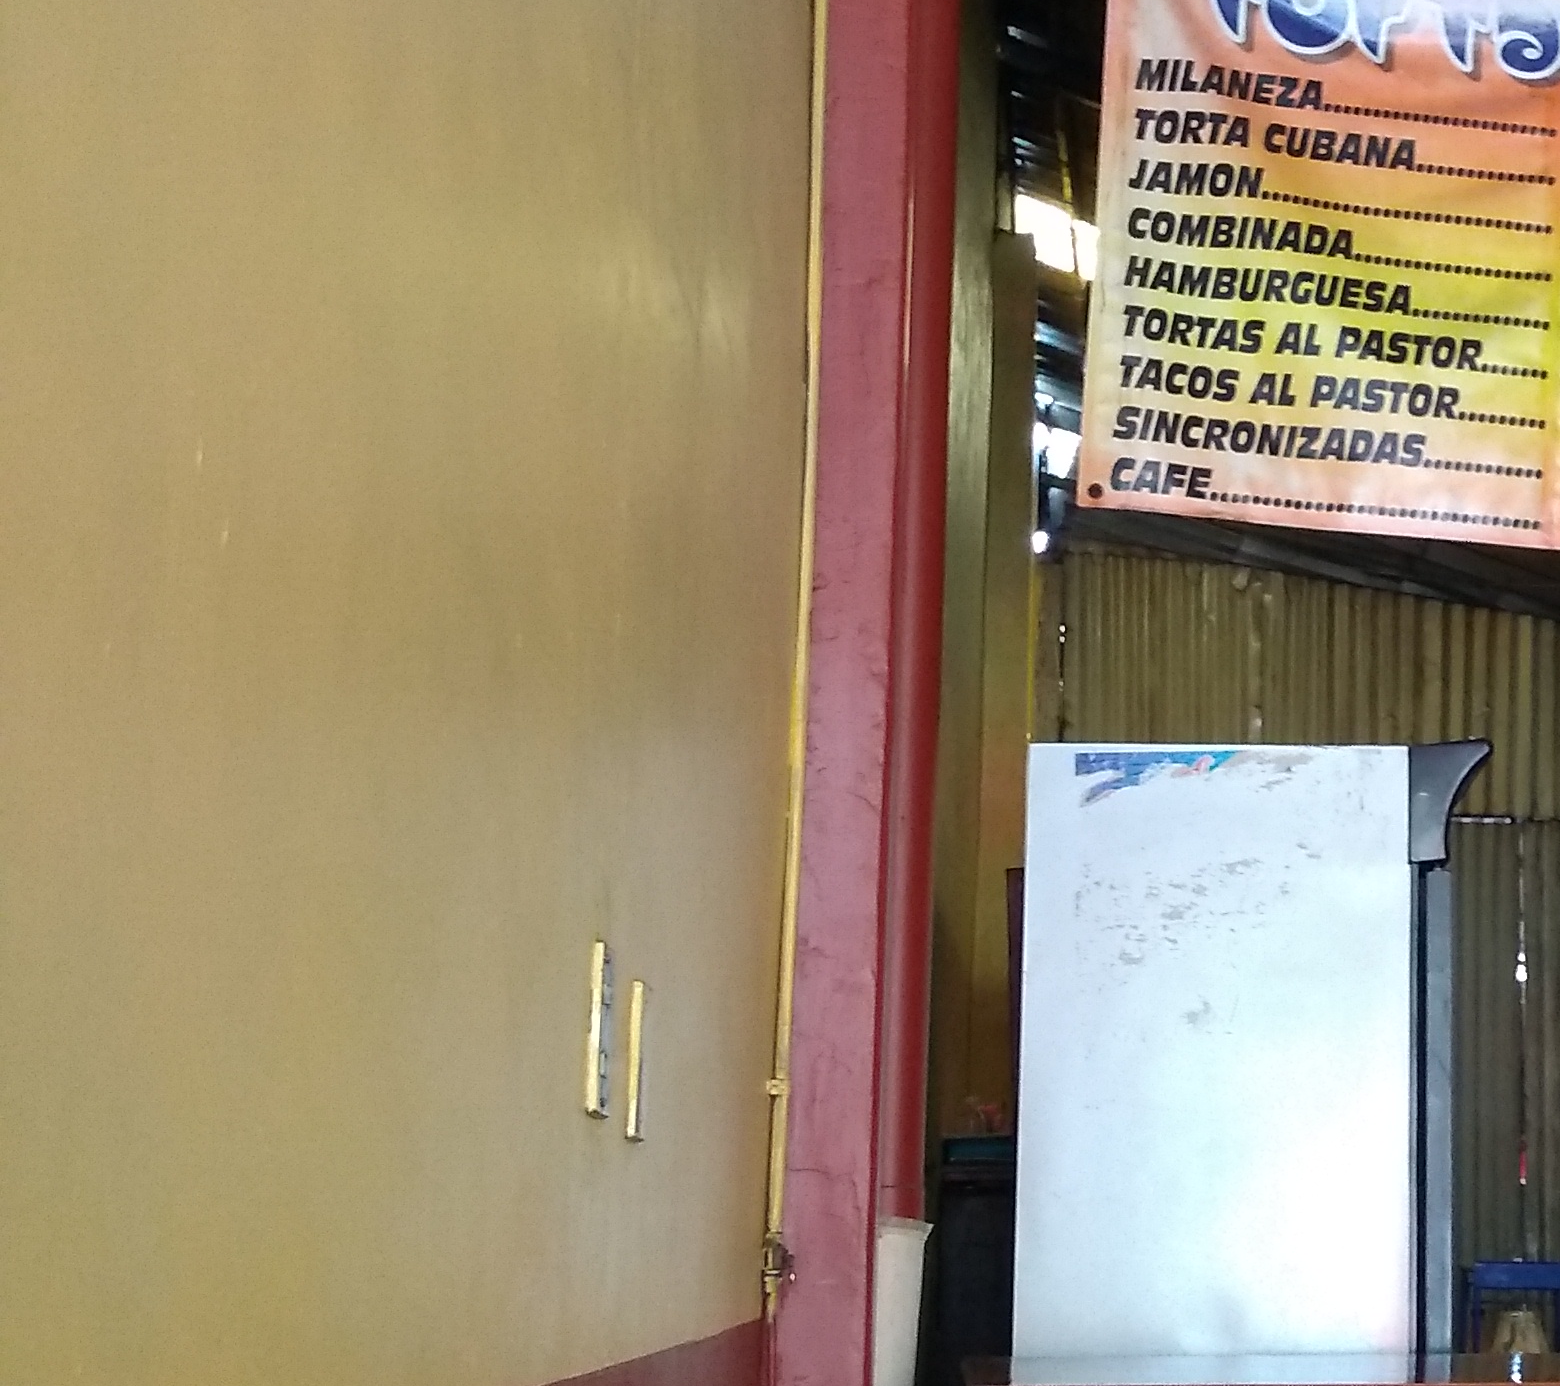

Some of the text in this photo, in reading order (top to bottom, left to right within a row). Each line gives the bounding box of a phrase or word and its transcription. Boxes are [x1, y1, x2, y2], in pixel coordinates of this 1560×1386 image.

[1134, 109, 1251, 148] TORTA
[1123, 304, 1265, 355] TORTAS
[1275, 321, 1321, 358] AL
[1119, 355, 1241, 403] TACOS
[1249, 373, 1297, 407] AL
